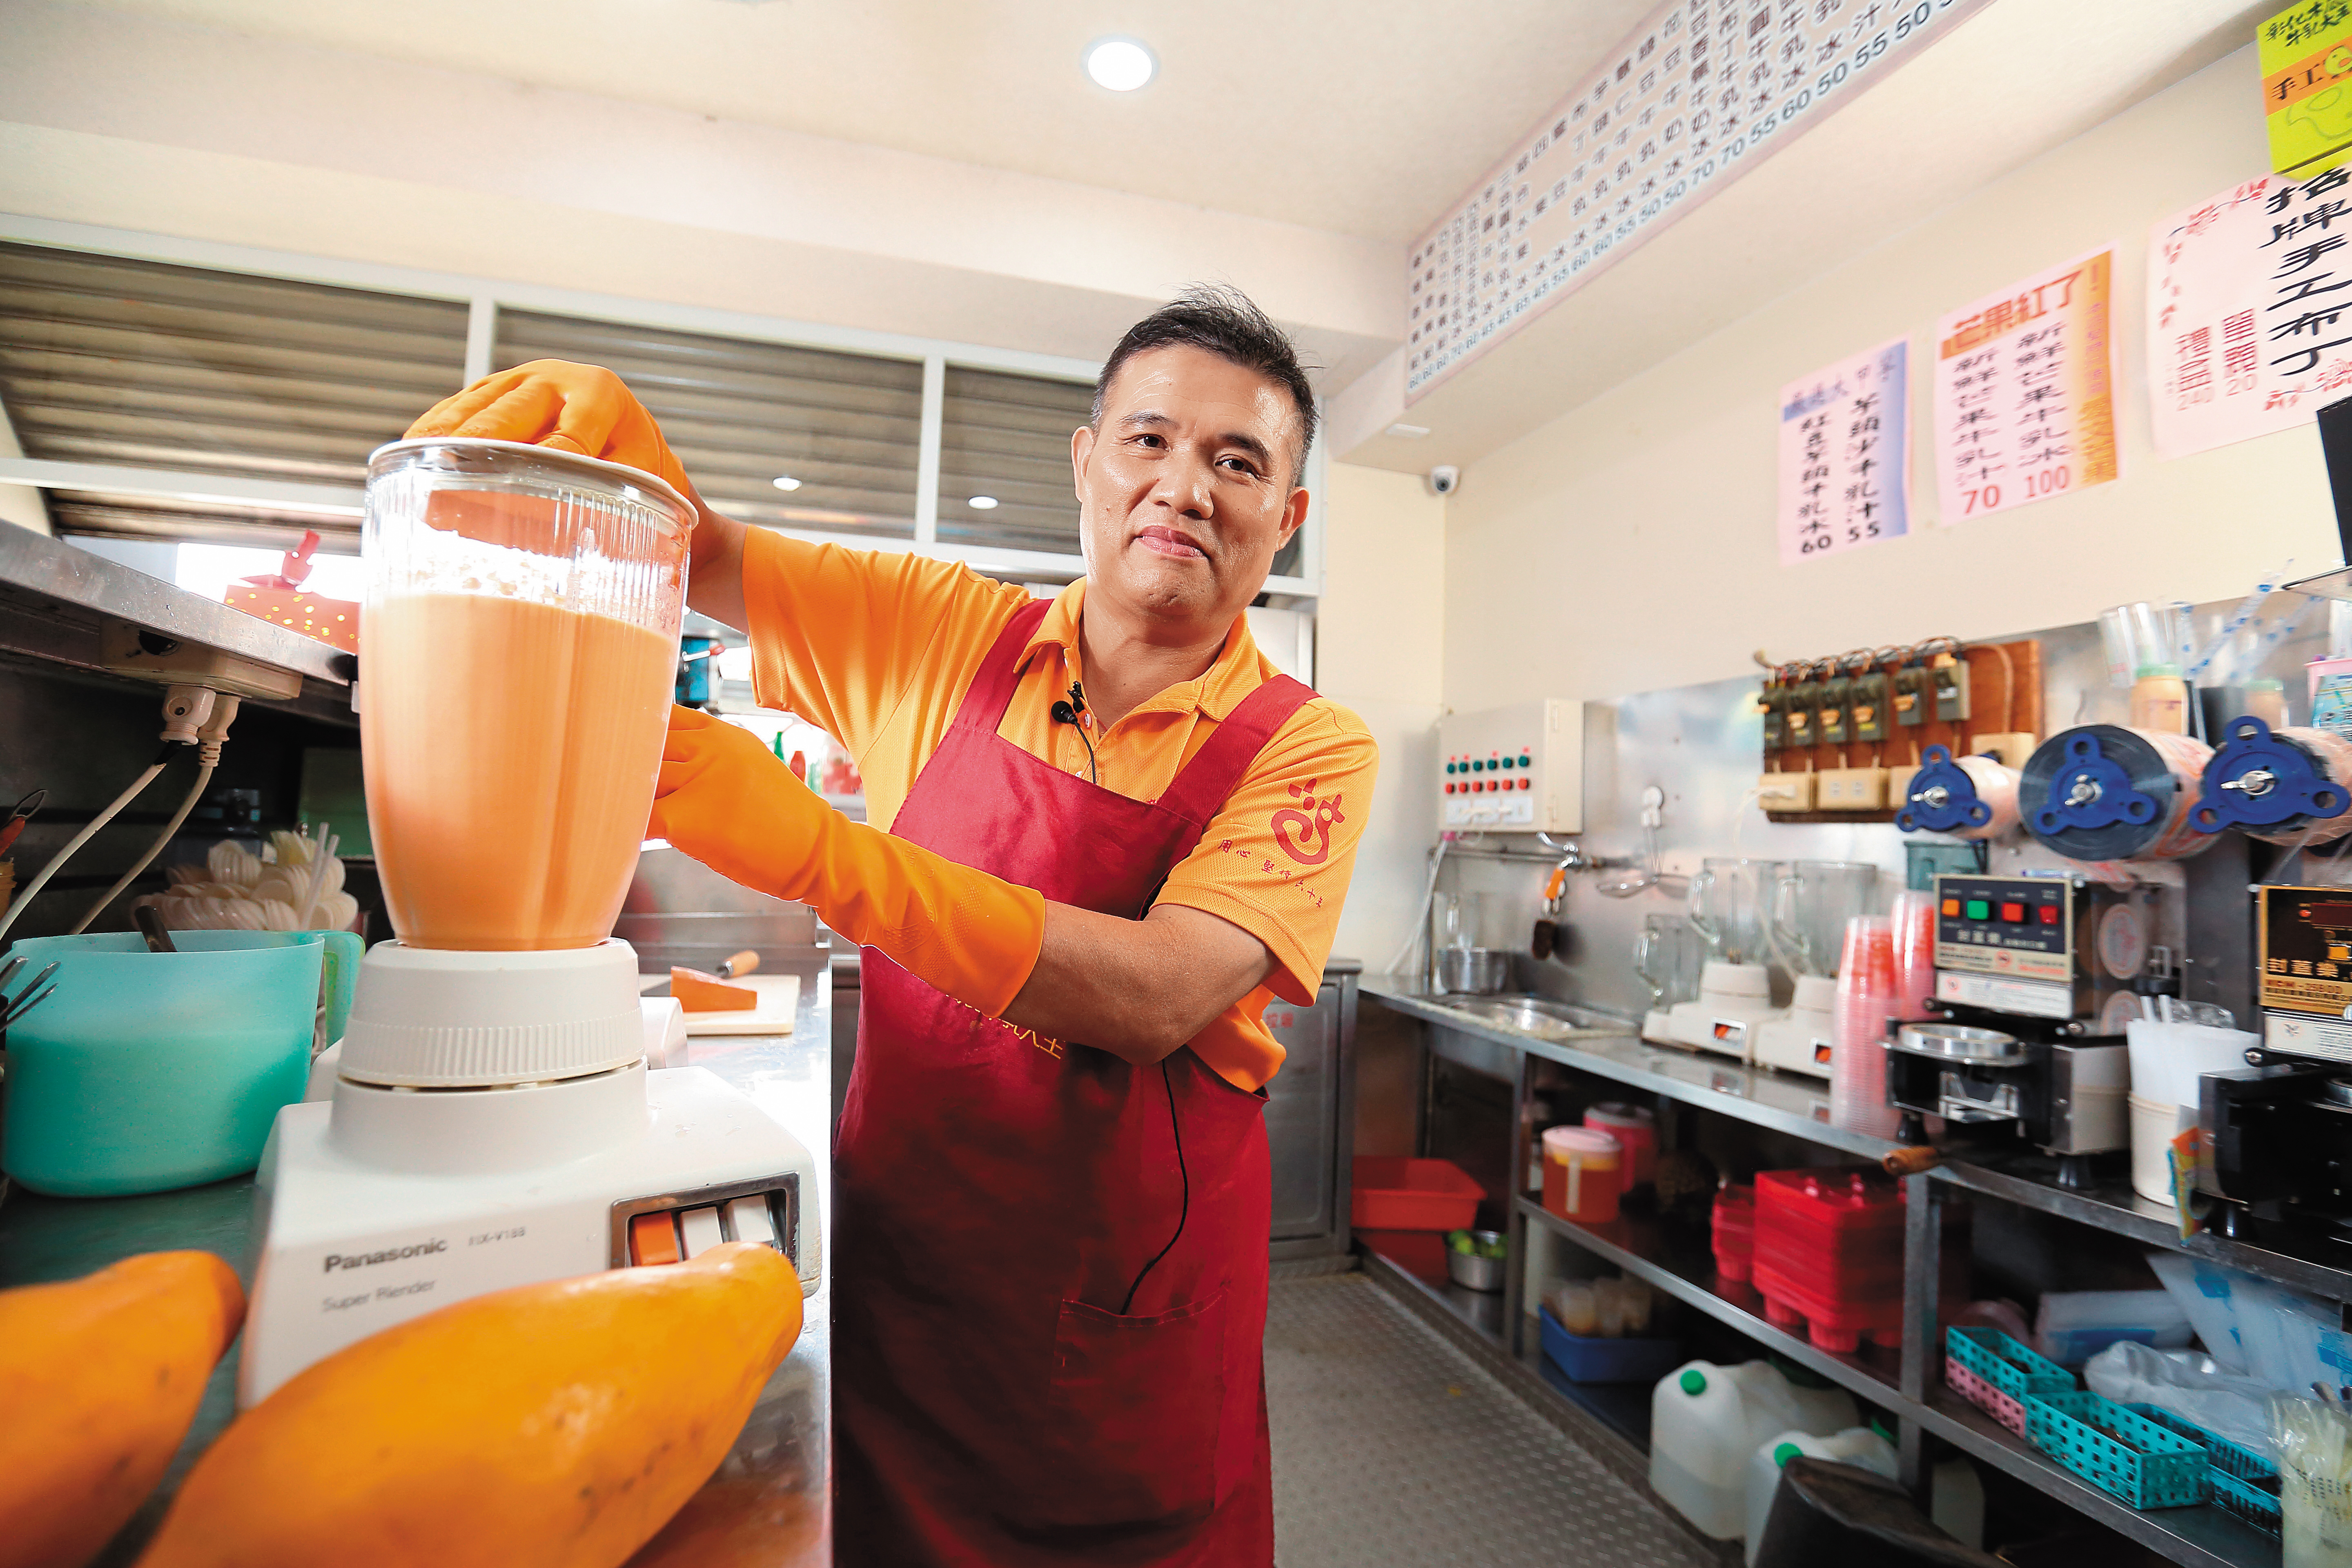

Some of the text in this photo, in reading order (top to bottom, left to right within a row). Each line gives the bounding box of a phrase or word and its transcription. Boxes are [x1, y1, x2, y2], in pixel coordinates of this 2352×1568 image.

[1896, 1, 1930, 39] 50
[1855, 32, 1888, 69] 55
[1817, 62, 1847, 95] 50
[2270, 58, 2344, 100] 手工
[1782, 90, 1810, 119] 60
[1750, 113, 1775, 143] 55
[1721, 138, 1746, 165] 70
[1693, 159, 1715, 186] 70
[1664, 180, 1686, 204] 50
[2256, 167, 2352, 376] 招牌手工布丁
[2015, 322, 2070, 468] 新鮮芒果牛乳冰
[2226, 374, 2256, 396] 20
[2026, 466, 2069, 498] 100
[1961, 485, 2000, 513] 70
[1802, 535, 1832, 555] 60
[1848, 521, 1881, 542] 55
[1218, 839, 1251, 858] 用心
[324, 1238, 448, 1272] Panasonic
[323, 1293, 371, 1312] Super
